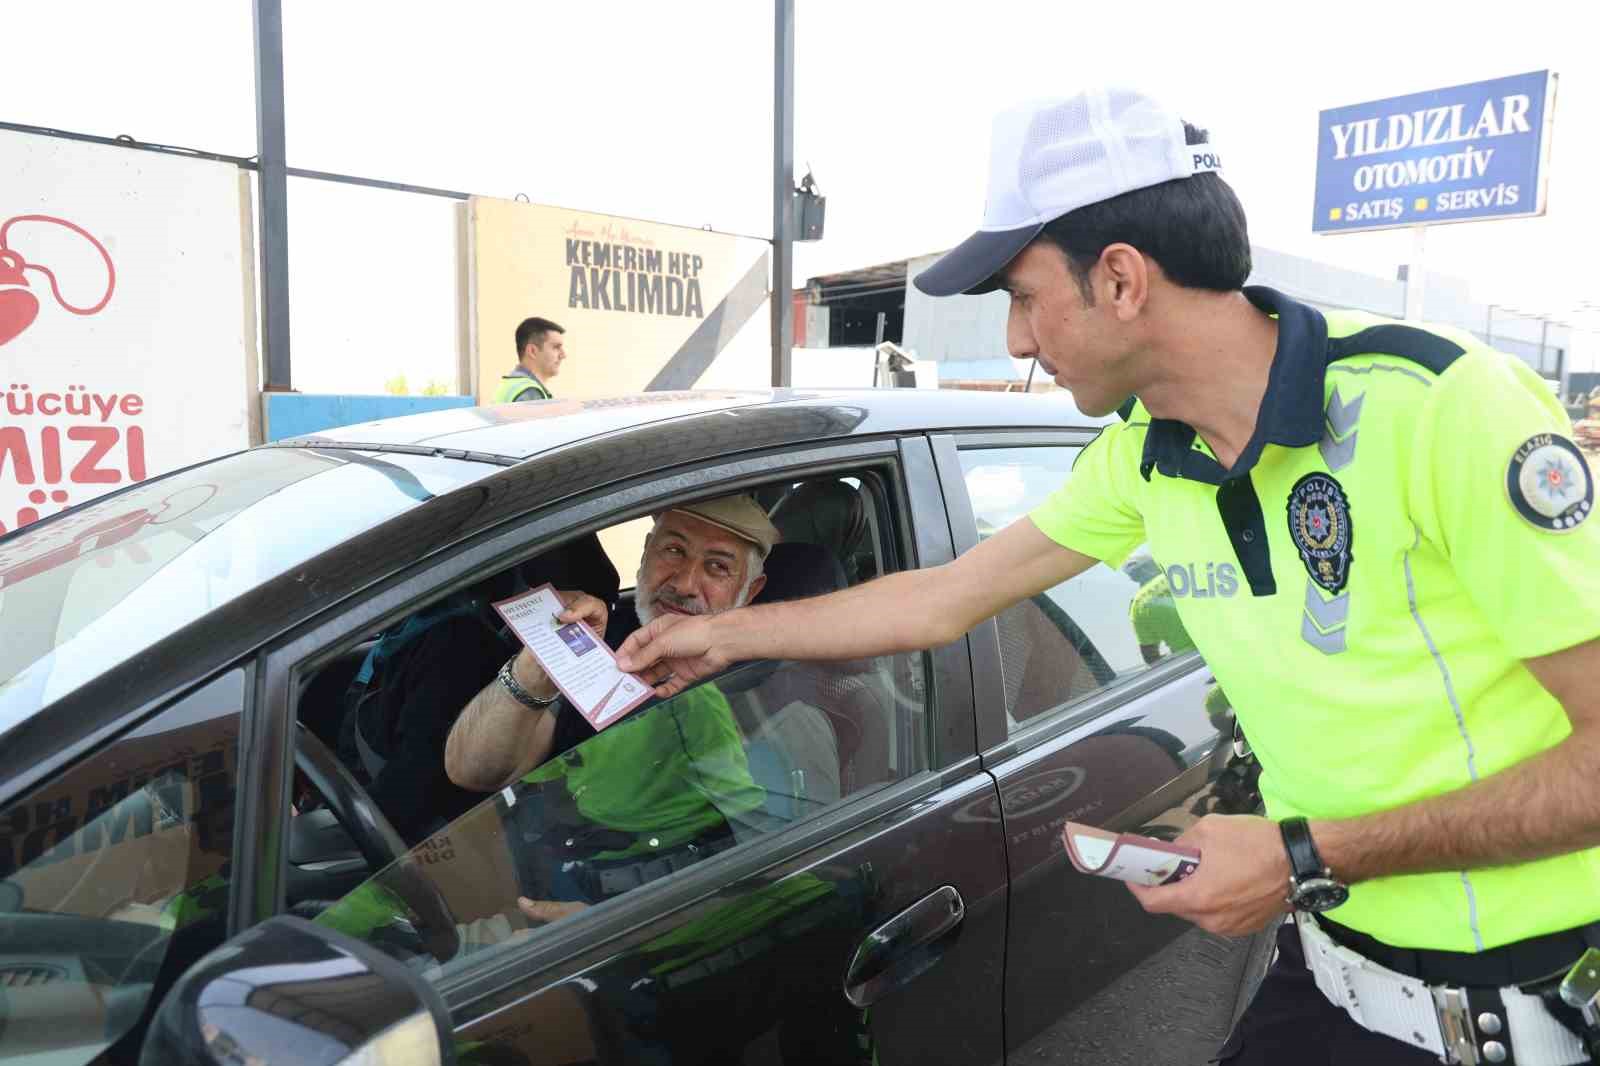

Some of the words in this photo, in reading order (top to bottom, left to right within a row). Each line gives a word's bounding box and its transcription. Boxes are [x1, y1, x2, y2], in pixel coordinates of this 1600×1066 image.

[1330, 94, 1531, 160] YILDIZLAR
[1353, 145, 1494, 192] OTOMOTİV
[1345, 197, 1404, 221] SATIŞ
[1435, 183, 1520, 212] SERVİS
[565, 237, 663, 274] KEMERİM
[668, 251, 703, 279] HEP
[568, 265, 704, 319] AKLIMDA
[0, 383, 144, 422] ücüye
[1167, 561, 1239, 598] OLİS
